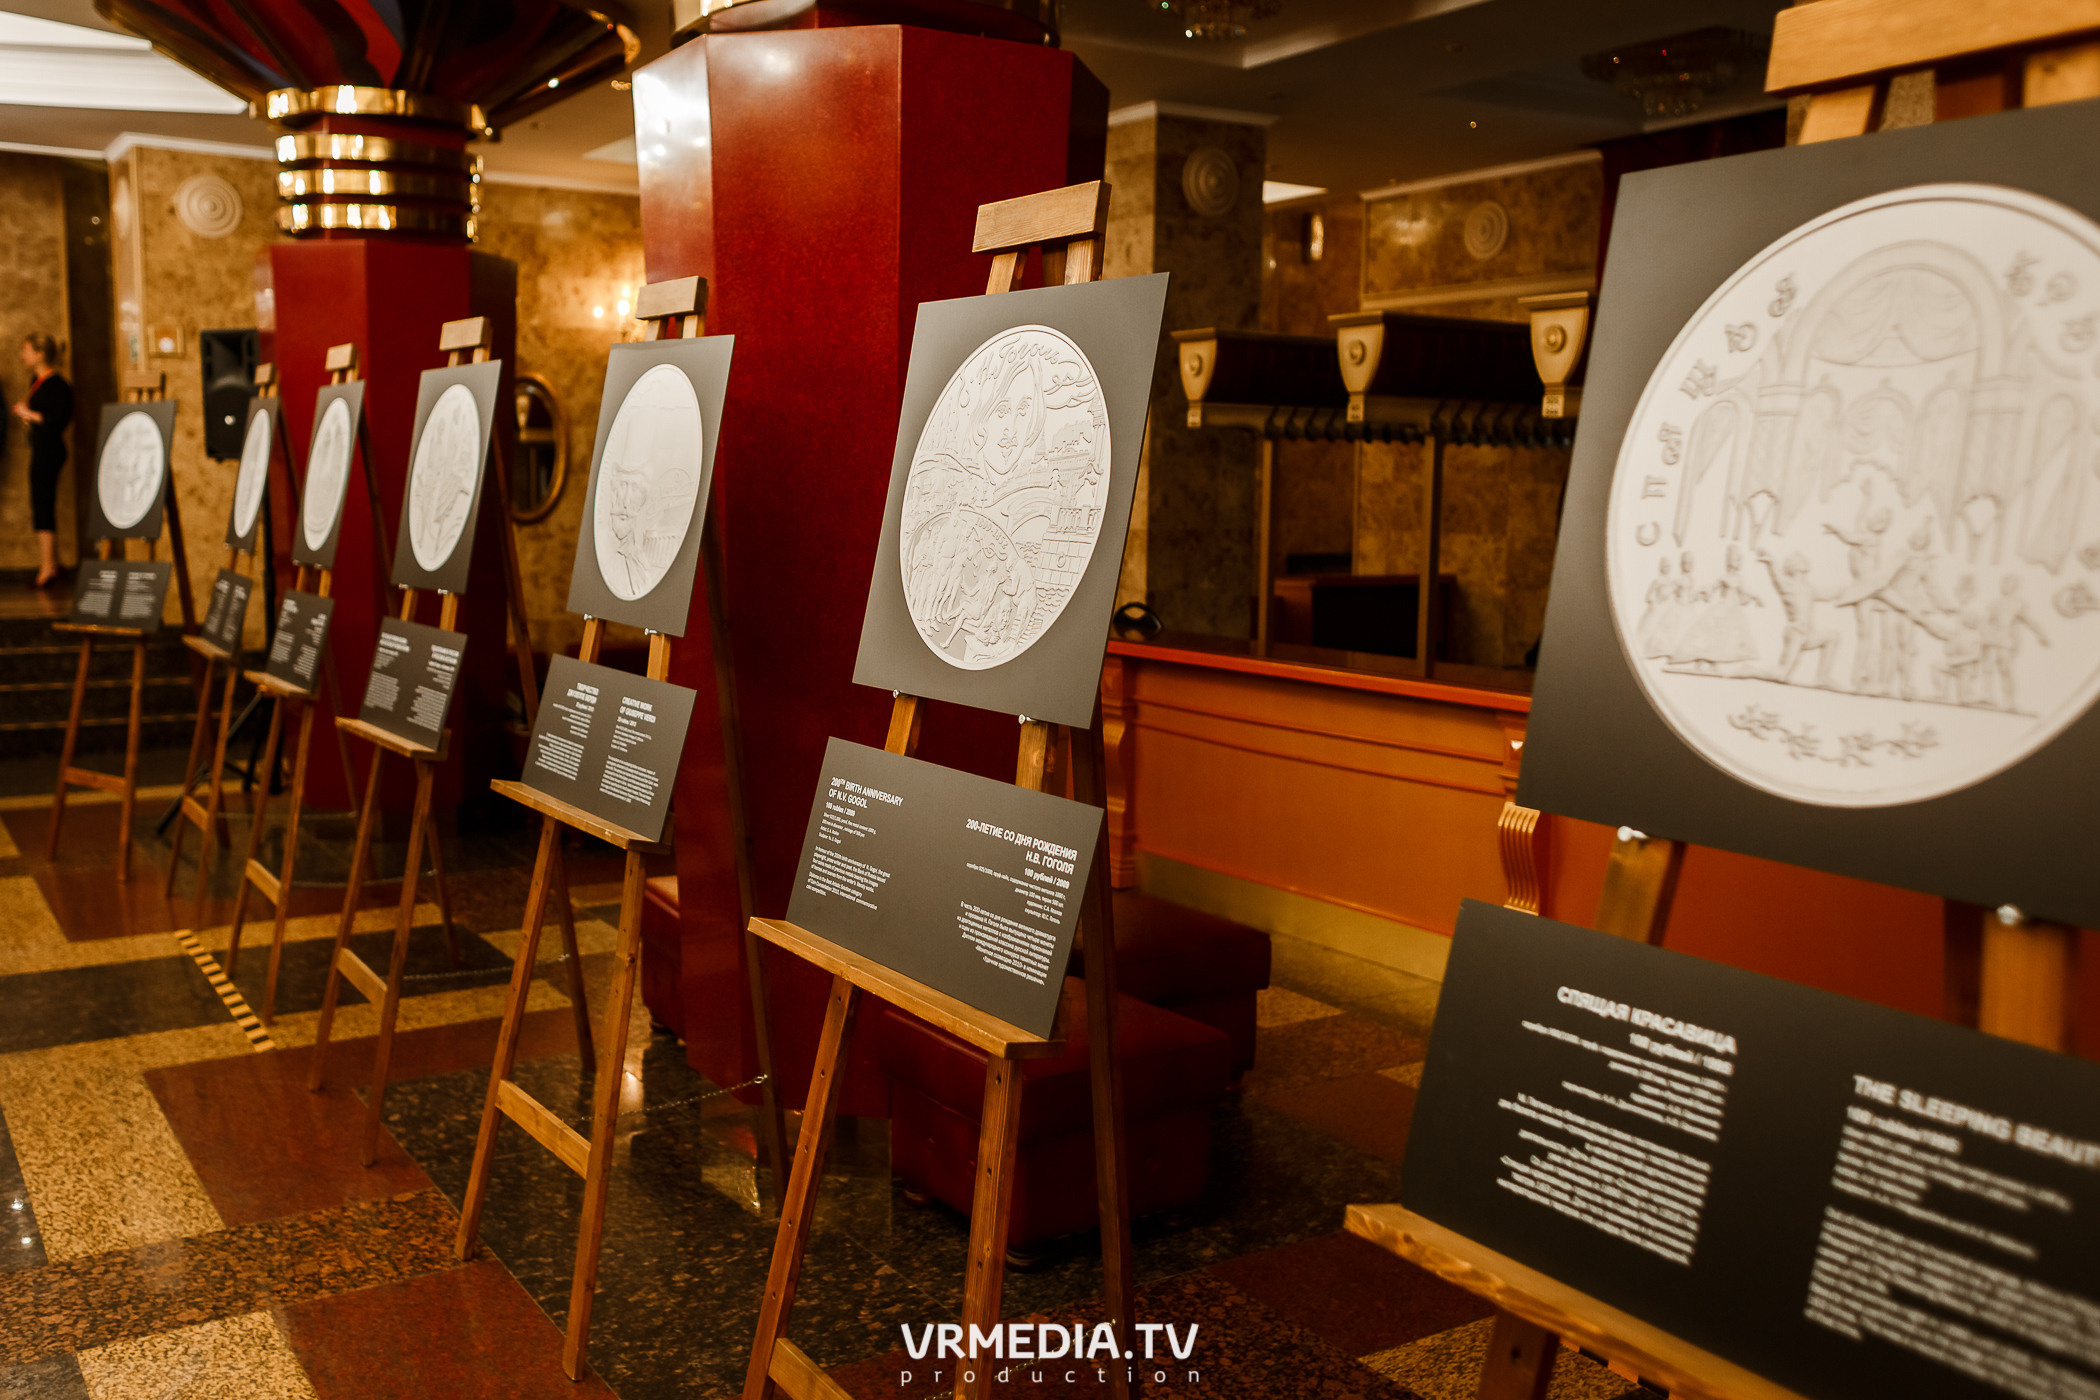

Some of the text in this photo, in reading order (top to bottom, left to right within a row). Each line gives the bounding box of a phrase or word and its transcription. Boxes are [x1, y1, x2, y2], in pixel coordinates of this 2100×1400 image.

[828, 788, 837, 798] OF
[847, 794, 867, 809] GOGOL
[845, 781, 862, 794] BIRTH
[862, 786, 903, 806] ANNIVERSARY
[966, 818, 1077, 861] 200-ЛЕТИЕ СО ДНЯ РОЖДЕНИЯ
[1026, 850, 1074, 875] Н.В. ГОГОЛЯ
[1852, 1074, 1898, 1106] THE
[1898, 1088, 2012, 1142] SLEEPING
[2015, 1124, 2100, 1167] BEAUT
